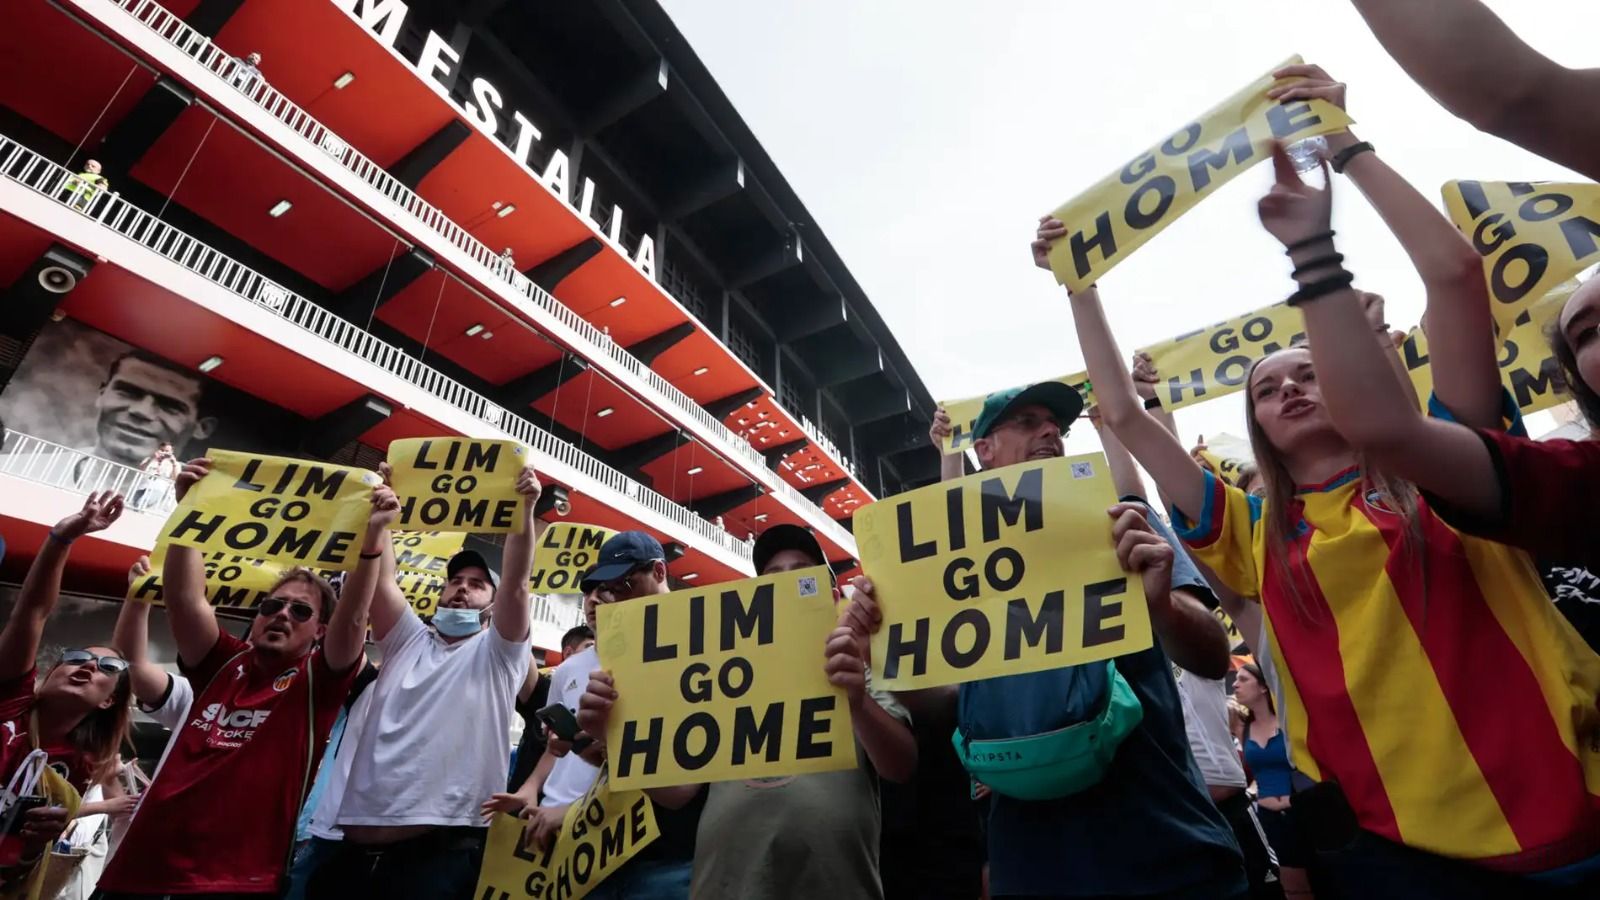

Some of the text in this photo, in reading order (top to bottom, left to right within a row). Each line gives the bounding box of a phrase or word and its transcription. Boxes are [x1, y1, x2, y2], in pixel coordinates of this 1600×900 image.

[1119, 122, 1202, 185] GO
[1070, 97, 1322, 280] HOME
[1473, 193, 1574, 256] GO
[1209, 316, 1273, 354] GO
[233, 459, 349, 500] LIM
[413, 440, 501, 473] LIM
[431, 474, 477, 494] GO
[250, 498, 311, 521] GO
[896, 468, 1044, 564] LIM
[168, 510, 357, 564] HOME
[543, 527, 605, 550] LIM
[556, 551, 589, 568] GO
[943, 546, 1026, 602] GO
[642, 583, 775, 663] LIM
[883, 577, 1127, 680] HOME
[680, 657, 754, 704] GO
[617, 695, 836, 778] HOME
[973, 752, 1023, 762] KIPSTA
[572, 798, 605, 840] GO
[557, 795, 647, 899] HOME
